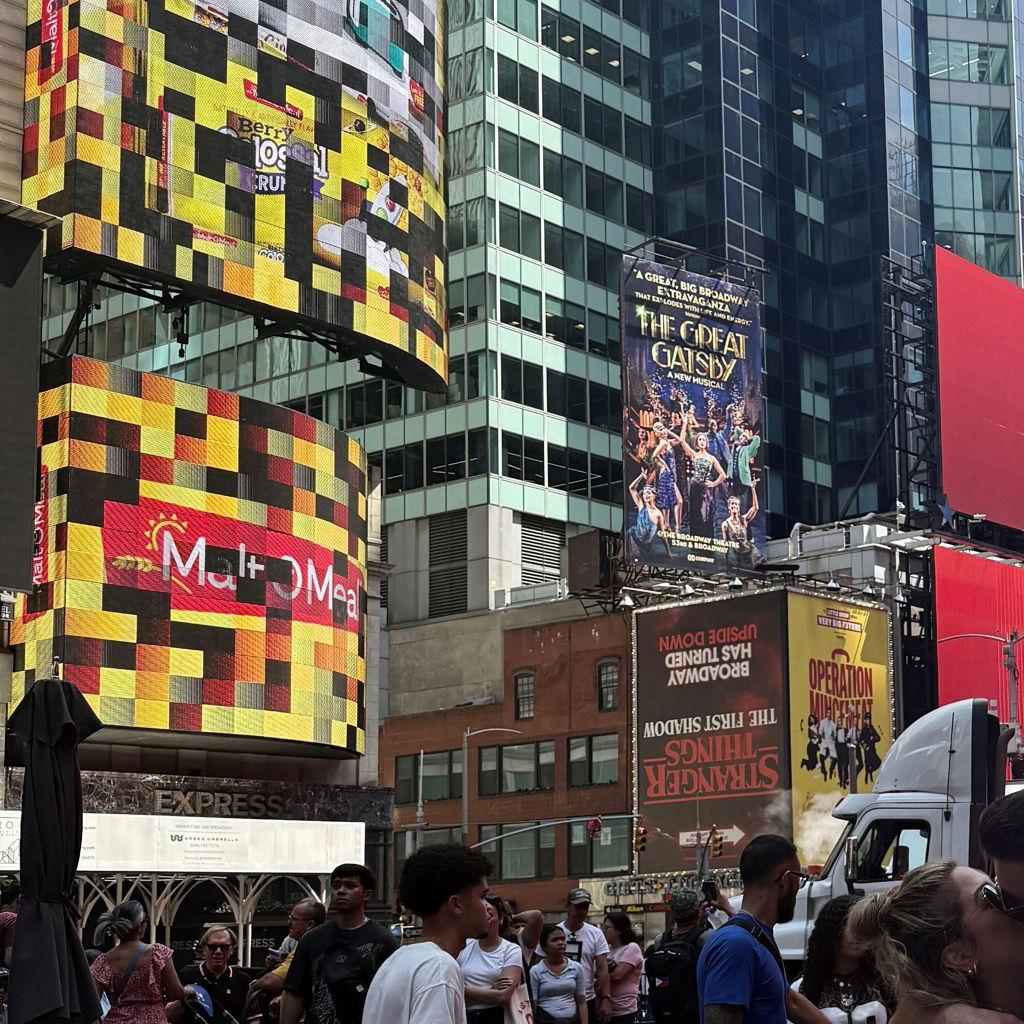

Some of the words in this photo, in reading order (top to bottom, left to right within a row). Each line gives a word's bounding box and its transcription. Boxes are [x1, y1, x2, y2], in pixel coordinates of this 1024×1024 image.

[238, 117, 295, 142] Berry
[645, 272, 679, 289] GREAT,
[680, 281, 697, 294] BIG
[699, 287, 750, 308] BROADWAY
[657, 286, 731, 314] EXTRAVAGANZA
[635, 291, 651, 301] THAT
[684, 303, 700, 313] WITH
[714, 311, 726, 320] AND
[638, 309, 676, 342] THE
[680, 320, 749, 360] GREAT
[651, 341, 738, 382] GATSBY
[667, 370, 674, 379] A
[674, 371, 692, 382] NEW
[692, 376, 725, 390] MUSICAL
[676, 532, 712, 544] BROADWAY
[694, 542, 729, 554] BROADWAY
[657, 629, 705, 652] DOWN
[709, 623, 758, 647] UPSIDE
[664, 647, 720, 669] TURNED
[721, 641, 752, 662] HAS
[667, 659, 750, 687] BROADWAY
[809, 658, 873, 698] OPERATION
[643, 717, 702, 739] SHADOW
[704, 711, 745, 731] FIRST
[747, 707, 778, 726] THE
[664, 733, 757, 767] THINGS
[643, 752, 780, 799] STRANGER
[154, 789, 285, 817] EXPRESS
